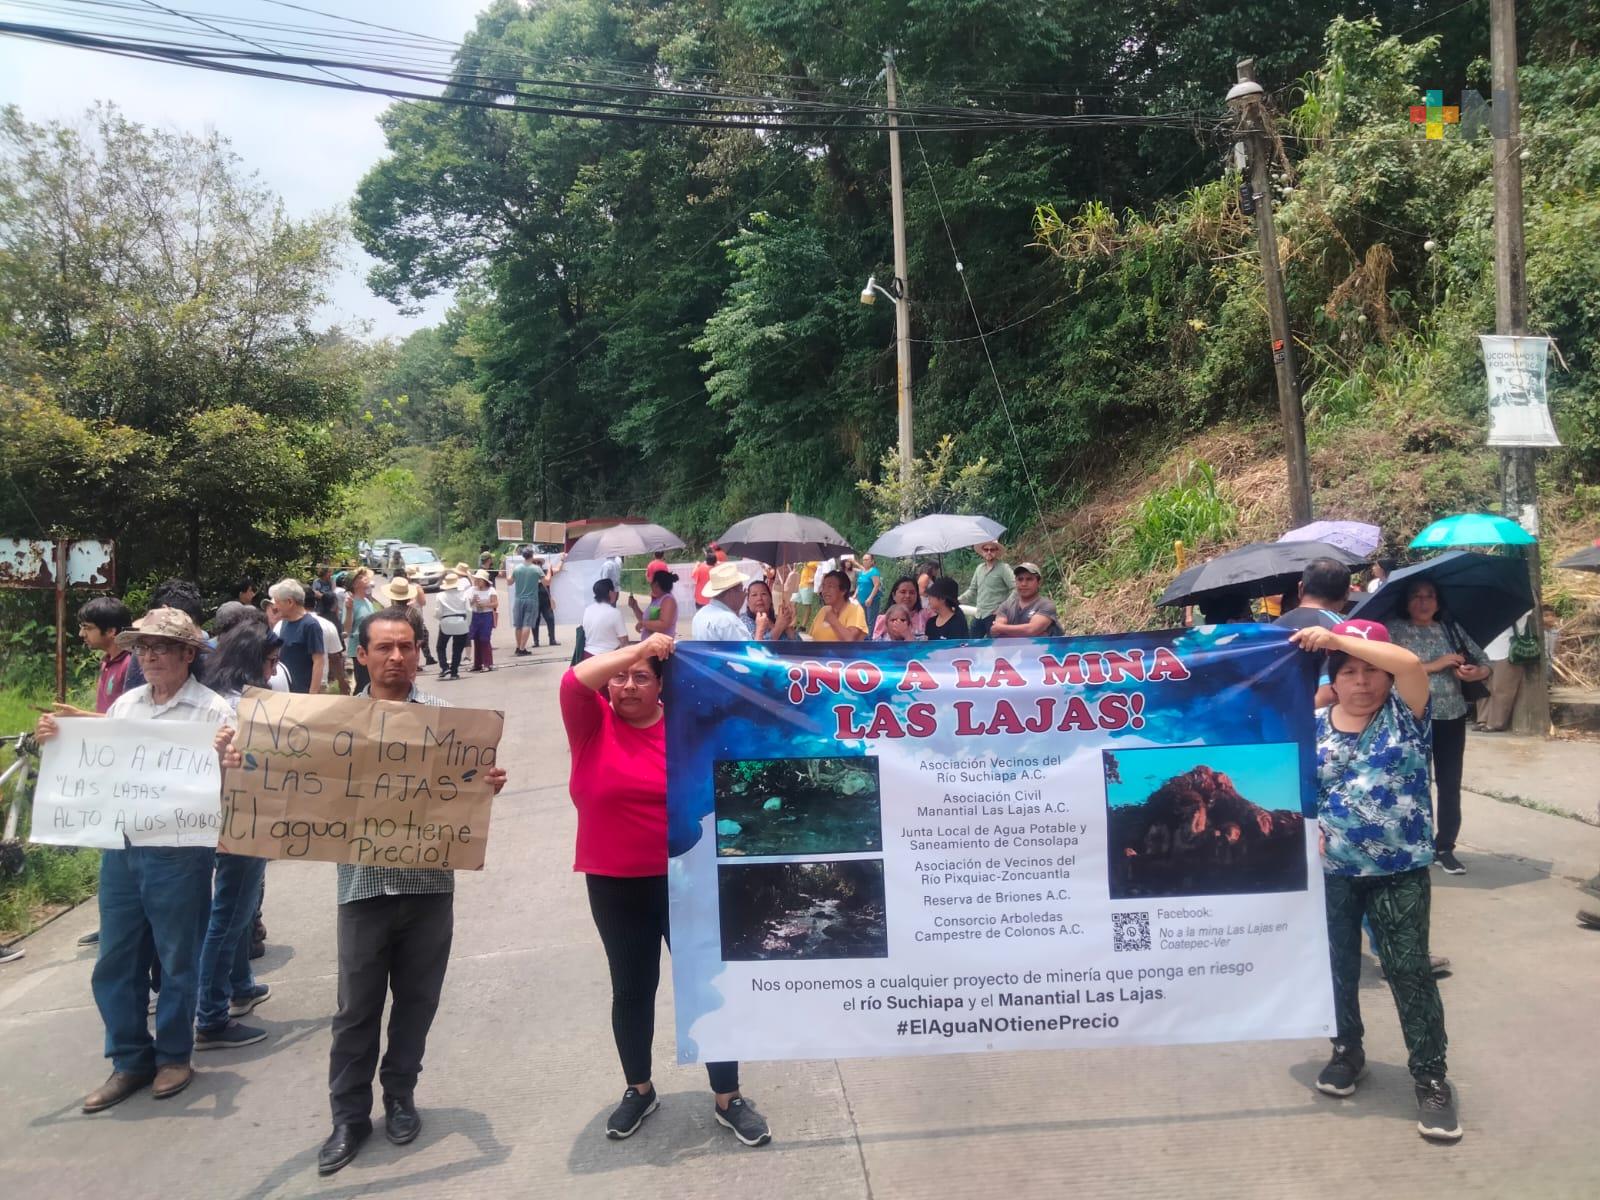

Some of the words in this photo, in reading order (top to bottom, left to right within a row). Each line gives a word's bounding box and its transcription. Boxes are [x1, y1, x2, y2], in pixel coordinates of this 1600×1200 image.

[788, 659, 883, 704] ¡NO
[898, 660, 939, 693] A
[952, 656, 1026, 689] LA
[1039, 647, 1190, 686] MINA
[834, 700, 938, 741] LAS
[953, 692, 1145, 738] LAJAS!
[246, 699, 310, 753] No
[333, 731, 352, 757] a
[378, 712, 407, 763] la
[422, 725, 497, 766] Mina
[78, 738, 115, 768] NO
[131, 744, 145, 771] A
[158, 746, 213, 776] MINA
[920, 759, 986, 770] Asociación
[990, 757, 1038, 768] Vecinos
[1042, 755, 1061, 766] del
[937, 773, 956, 783] Río
[960, 772, 1017, 782] Suchiapa
[1021, 770, 1045, 780] A.C.
[944, 792, 1010, 803] Asociación
[1015, 790, 1041, 800] Civil
[917, 806, 977, 816] Manantial
[982, 805, 1004, 815] Las
[1008, 804, 1040, 815] Lajas
[1044, 803, 1069, 813] A.C.
[54, 806, 101, 829] ALTO
[115, 809, 125, 832] A
[135, 812, 166, 832] LOS
[270, 820, 348, 856] agua
[364, 816, 397, 838] no
[403, 810, 471, 843] tiene
[901, 827, 933, 837] Junta
[938, 826, 970, 836] Local
[975, 825, 989, 835] de
[994, 825, 1025, 836] Agua
[1030, 822, 1076, 833] Potable
[1080, 824, 1086, 834] y
[910, 840, 990, 850] Saneamiento
[994, 838, 1009, 847] de
[1013, 836, 1078, 849] Consolapa
[348, 838, 450, 867] Precio!
[915, 859, 981, 871] Asociación
[986, 858, 1000, 868] de
[1004, 857, 1053, 868] Vecinos
[1057, 856, 1075, 865] del
[924, 895, 973, 906] Reserva
[977, 894, 991, 903] de
[996, 892, 1042, 903] Briones
[1046, 890, 1070, 900] A.C.
[934, 915, 996, 927] Consorcio
[1000, 912, 1063, 924] Arboledas
[1157, 907, 1213, 919] Facebook:
[915, 929, 981, 943] Campestre
[986, 928, 1000, 938] de
[1005, 926, 1055, 937] Colonos
[1059, 924, 1084, 935] A.C.
[1159, 928, 1174, 938] No
[1186, 927, 1195, 937] la
[1199, 927, 1224, 936] mina
[1227, 926, 1245, 935] Las
[1247, 924, 1273, 935] Lajas
[1275, 923, 1288, 932] en
[1160, 938, 1231, 950] Coatepec-Ver
[752, 978, 780, 991] Nos
[785, 977, 862, 992] oponemos
[867, 978, 875, 989] a
[880, 974, 949, 990] cualquier
[953, 972, 1019, 989] proyecto
[1023, 971, 1041, 983] de
[1046, 968, 1100, 983] minería
[1105, 968, 1133, 983] que
[1138, 965, 1183, 981] ponga
[1188, 965, 1205, 975] en
[1210, 961, 1254, 975] riesgo
[843, 997, 855, 1010] el
[860, 995, 882, 1010] río
[886, 994, 964, 1010] Suchiapa
[968, 997, 976, 1010] y
[981, 994, 993, 1007] el
[999, 989, 1080, 1007] Manantial
[1086, 989, 1114, 1003] Las
[1119, 986, 1166, 1003] Lajas.
[897, 1013, 1119, 1037] #ElAguaNOtienePrecio
